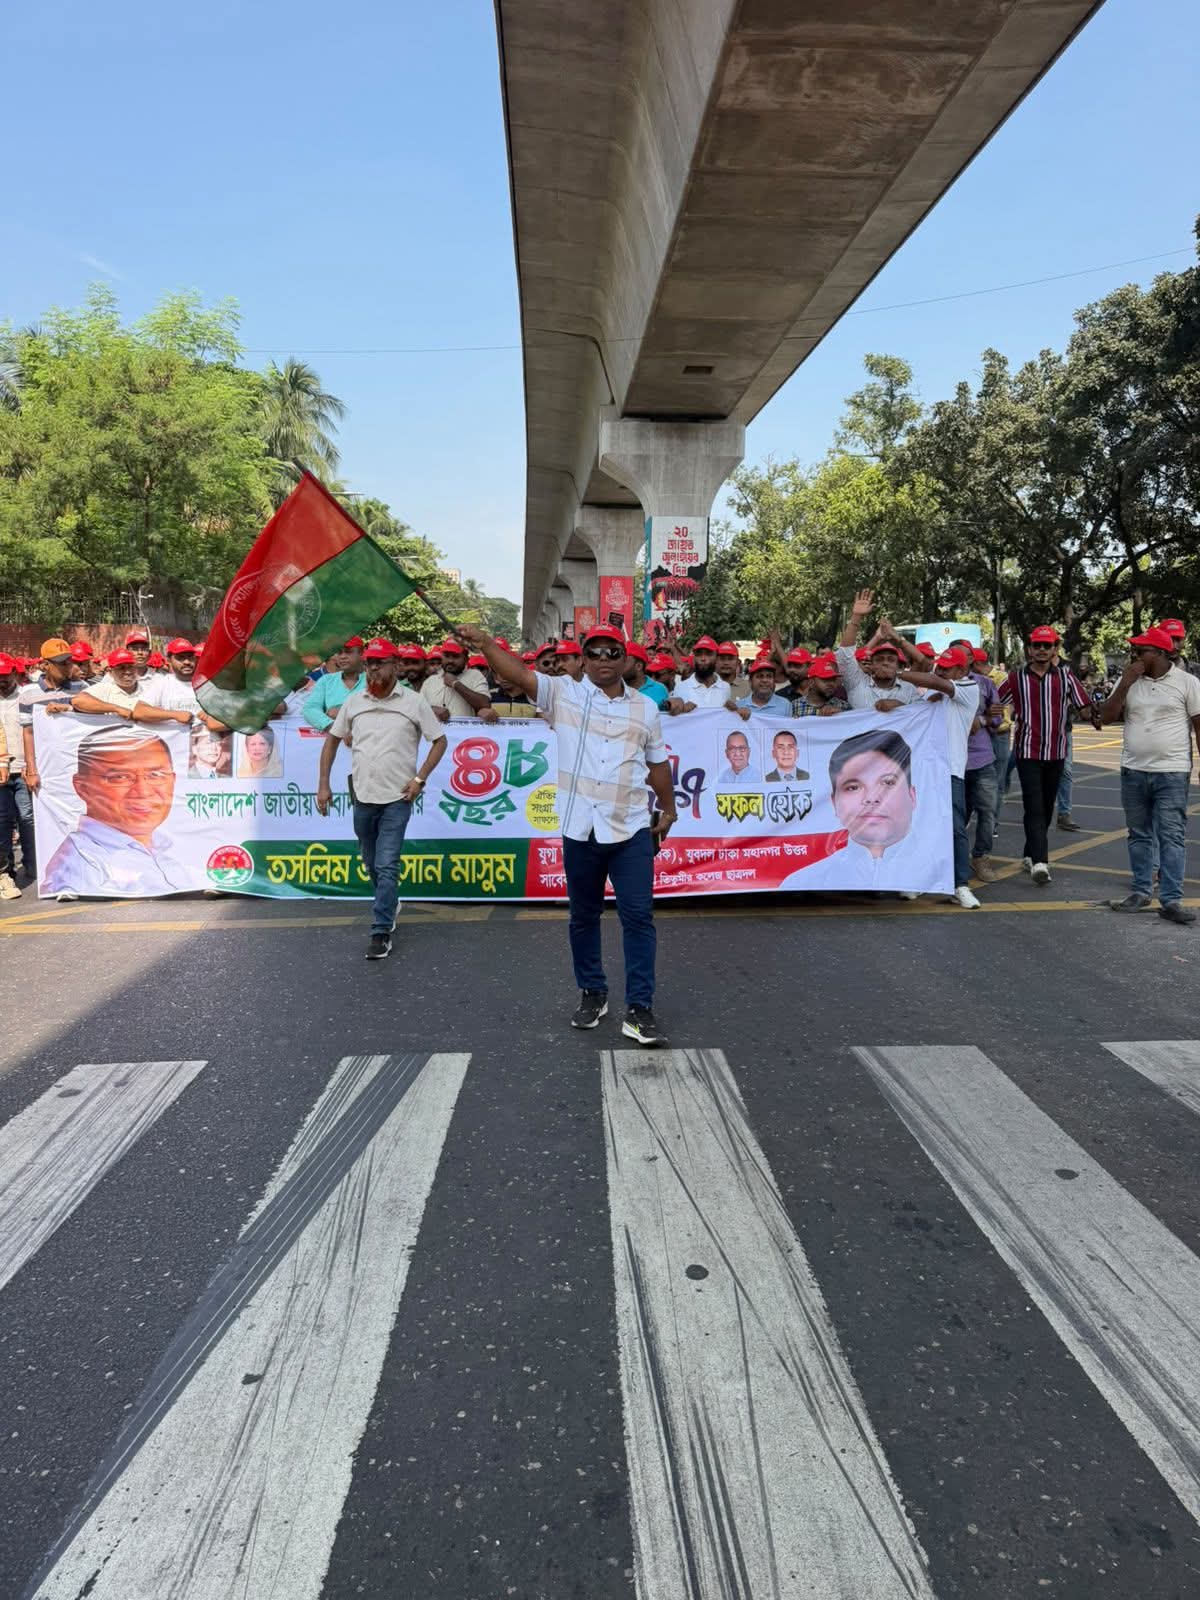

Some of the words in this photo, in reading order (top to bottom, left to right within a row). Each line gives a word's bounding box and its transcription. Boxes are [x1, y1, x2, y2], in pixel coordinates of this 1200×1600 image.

[187, 791, 258, 818] বাংলাদেশ
[438, 789, 518, 826] বছর
[716, 792, 765, 822] সফল
[766, 787, 813, 823] হোক
[266, 843, 352, 885] তসলিম
[449, 854, 516, 894] মাসুম
